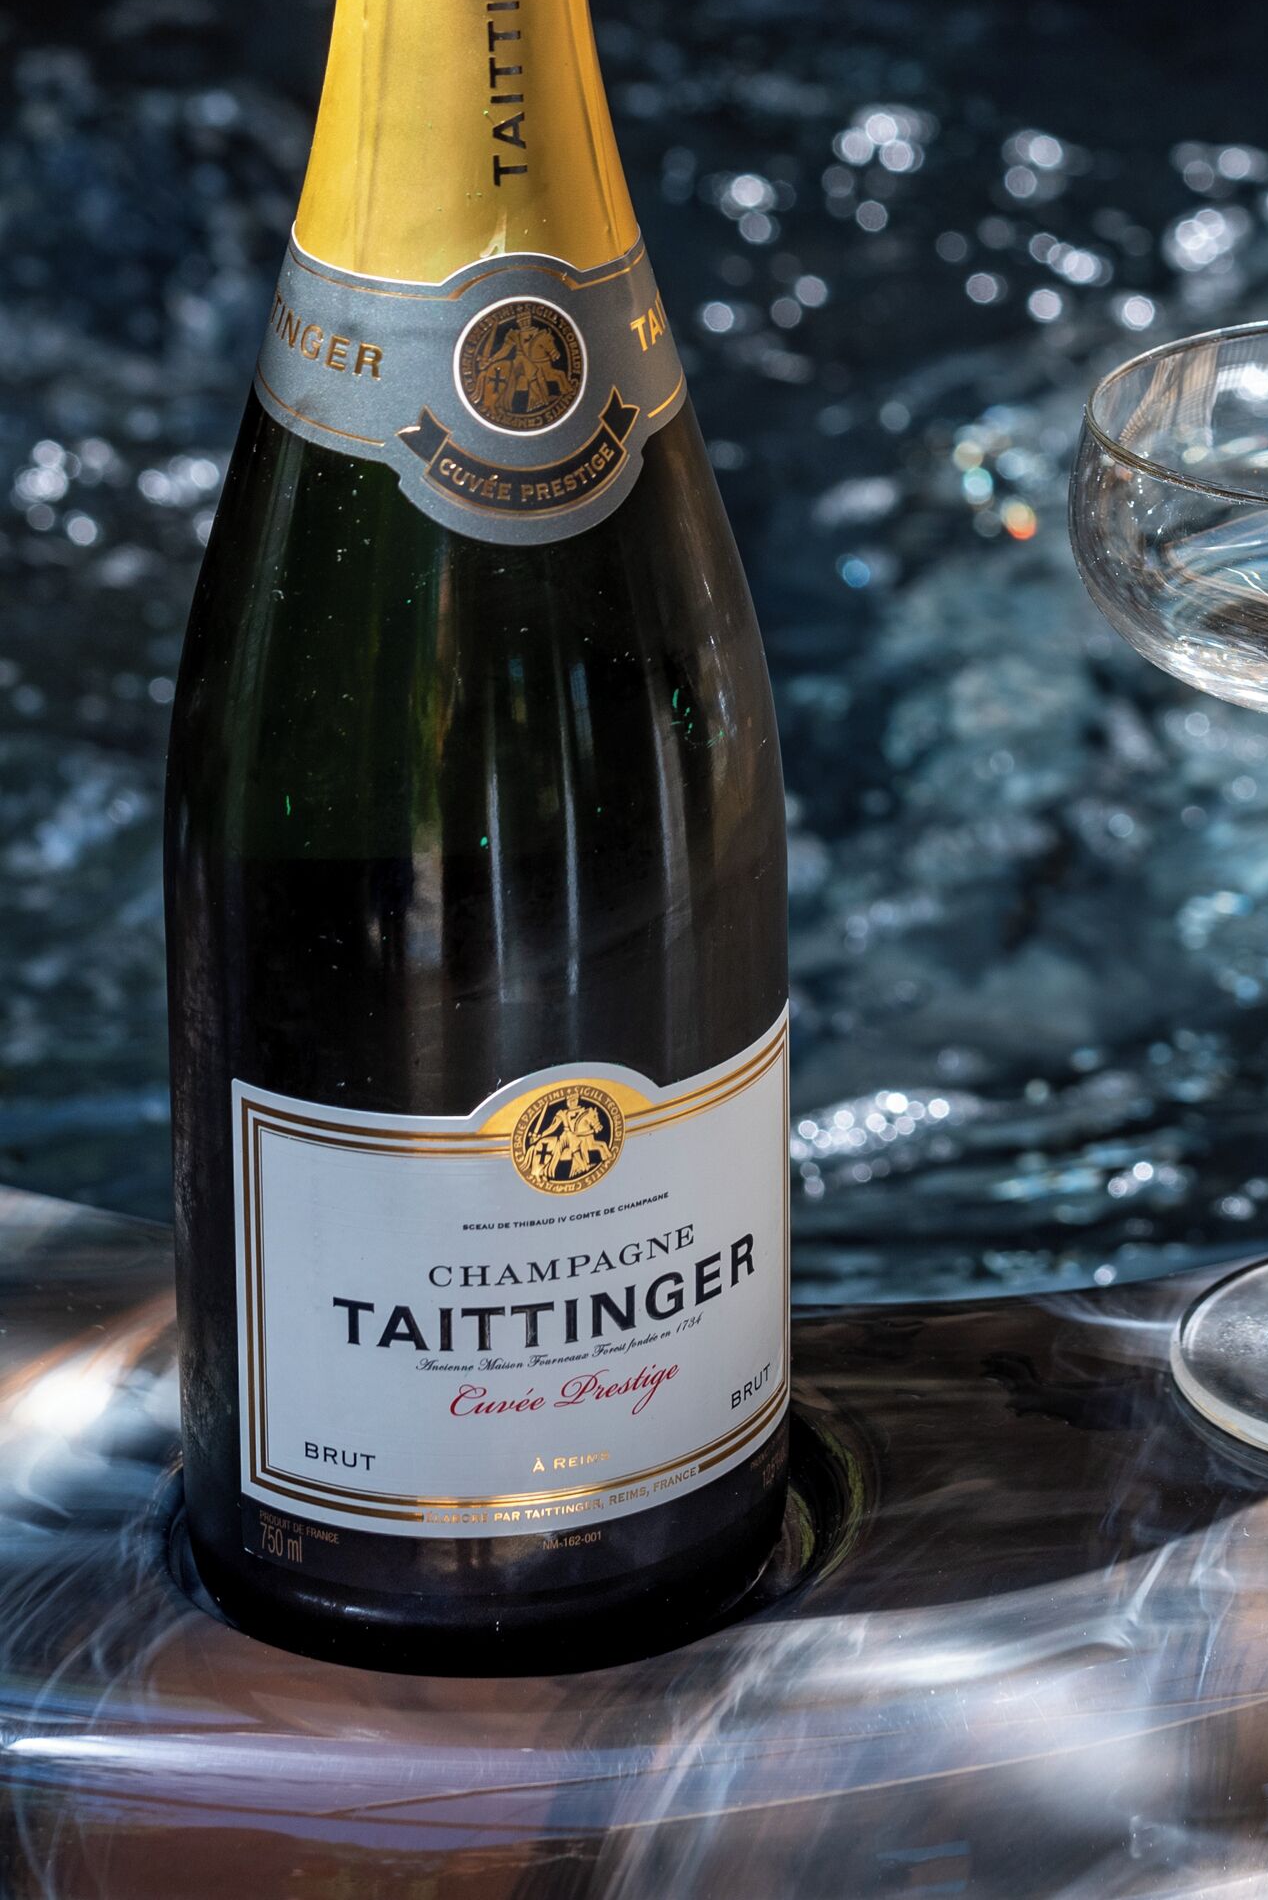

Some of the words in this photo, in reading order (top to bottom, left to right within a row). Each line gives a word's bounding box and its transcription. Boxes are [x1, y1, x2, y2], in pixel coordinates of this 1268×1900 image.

[439, 458, 512, 501] CUVÉE
[520, 442, 615, 502] PRESTIGE
[462, 1223, 495, 1231] SCEAU
[513, 1218, 555, 1228] THIBAUD
[557, 1215, 567, 1224] IV
[569, 1210, 601, 1221] COMTE
[603, 1207, 616, 1216] DE
[617, 1191, 670, 1212] CHAMPAGNE
[428, 1224, 696, 1288] CHAMPAGNE
[332, 1233, 756, 1352] TAITTINGER
[415, 1358, 475, 1372] Ancienne
[477, 1358, 524, 1372] Maison
[529, 1353, 589, 1368] Fourneaux
[593, 1343, 627, 1357] Forest
[626, 1333, 659, 1355] fondée
[660, 1330, 672, 1340] en
[676, 1312, 704, 1335] 1734
[450, 1384, 546, 1417] Cuvée
[553, 1363, 680, 1416] Prestige
[731, 1362, 771, 1410] BRUT
[304, 1441, 376, 1471] BRUT
[532, 1457, 545, 1473] À
[553, 1451, 610, 1470] REIMS
[494, 1511, 521, 1522] PAR
[525, 1498, 605, 1520] TAITTINGER,
[608, 1487, 650, 1505] REIMS,
[653, 1467, 697, 1494] FRANCE
[259, 1509, 290, 1530] PRODUIT
[293, 1522, 304, 1535] DE
[260, 1521, 284, 1557] 750
[287, 1535, 303, 1564] ml
[542, 1530, 602, 1551] NM-162-001
